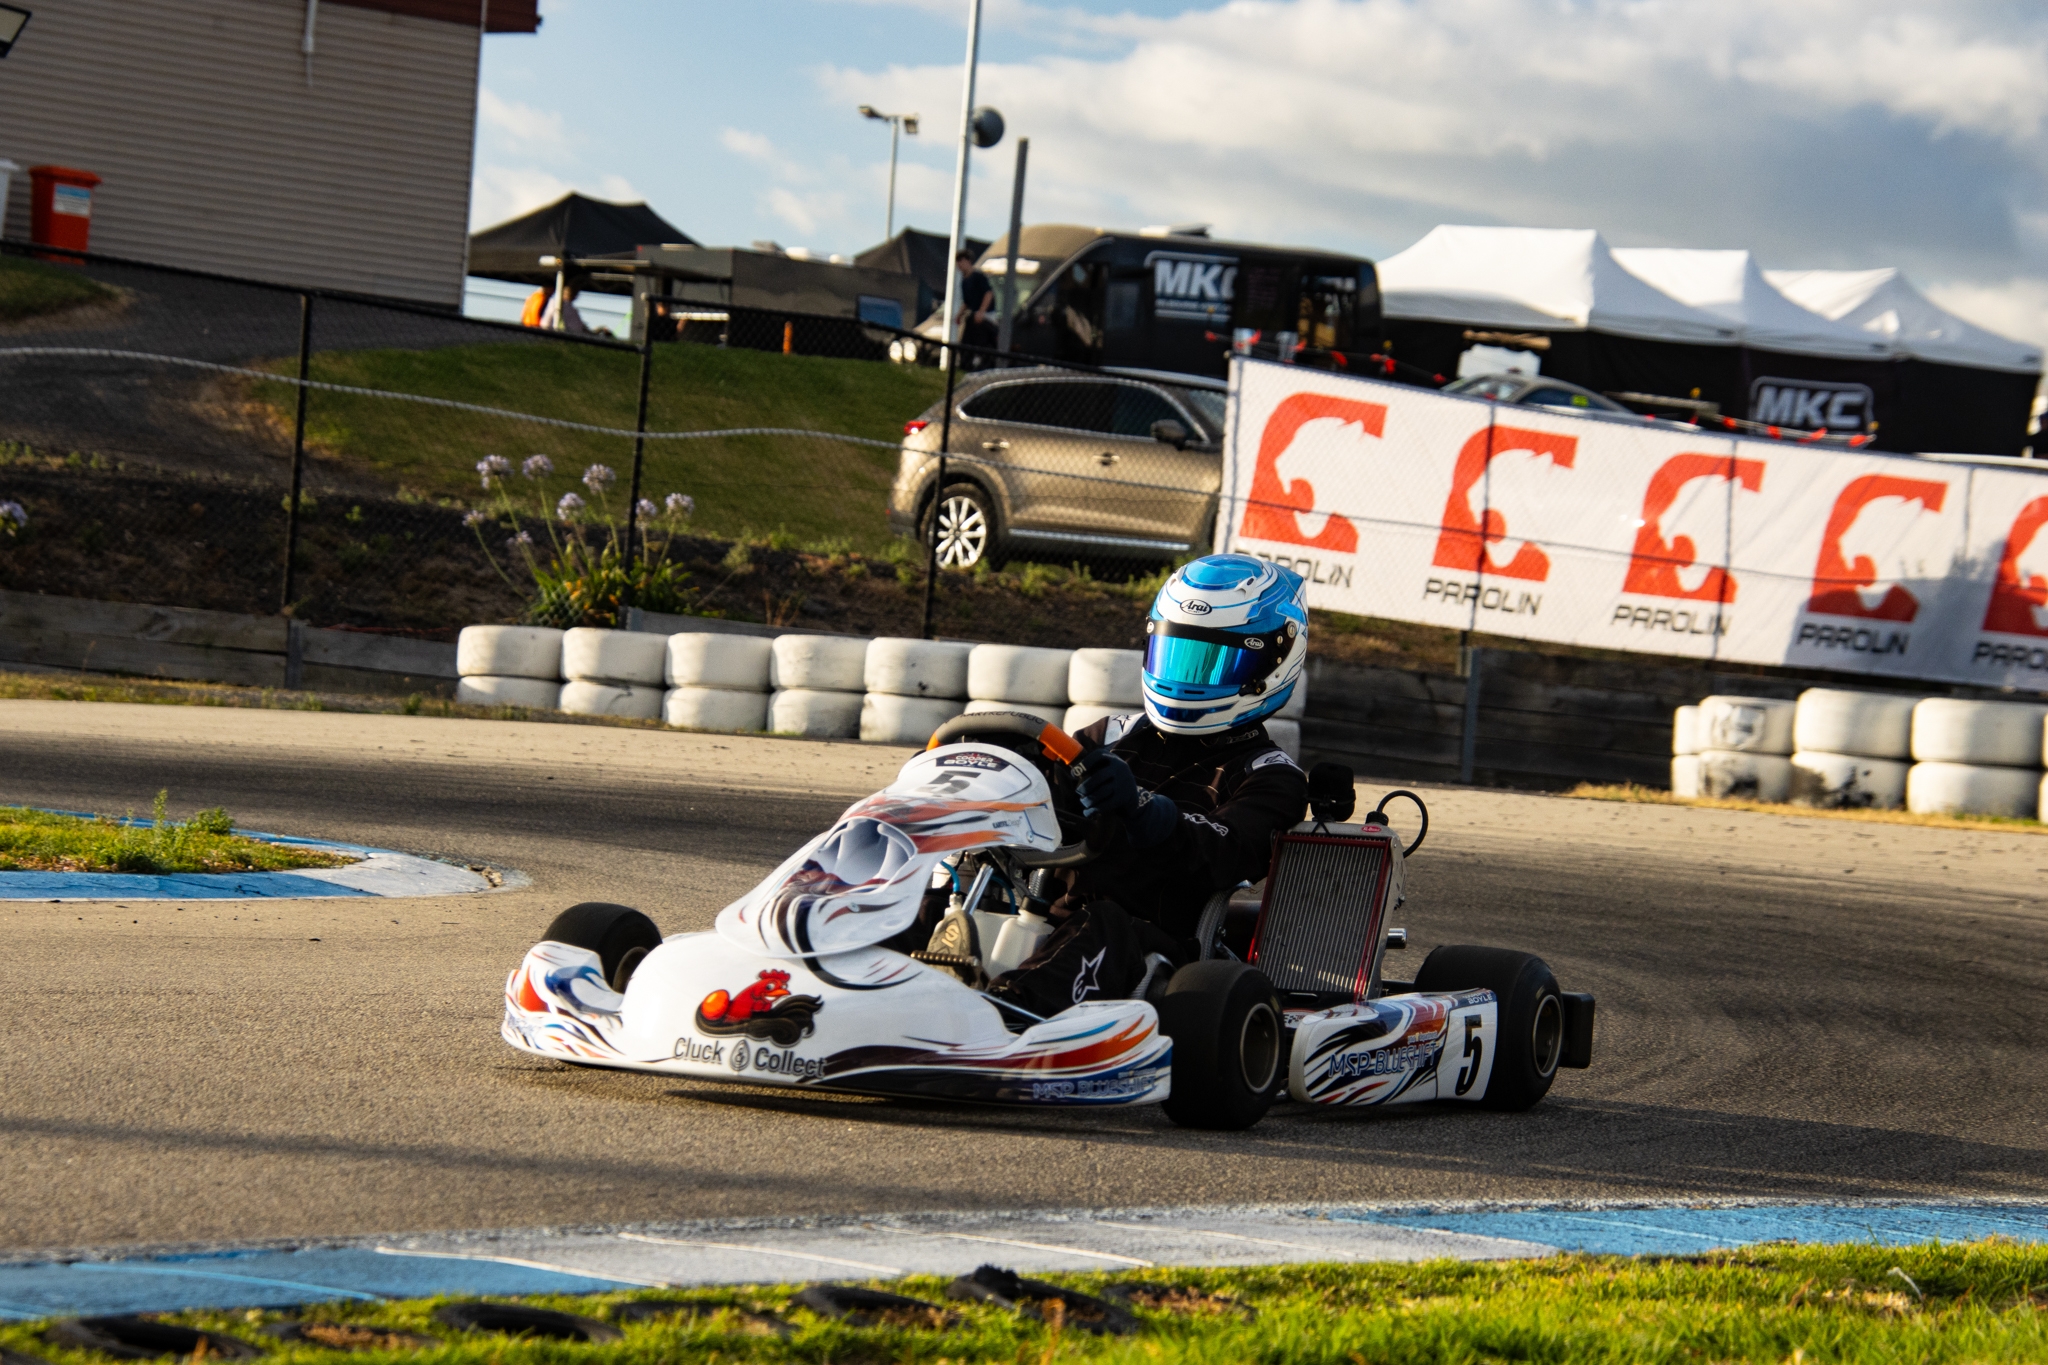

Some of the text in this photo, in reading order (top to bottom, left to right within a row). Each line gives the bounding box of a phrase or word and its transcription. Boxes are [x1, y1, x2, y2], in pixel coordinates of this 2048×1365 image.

[1755, 386, 1866, 428] MKC
[1187, 600, 1208, 612] Arai
[1423, 577, 1543, 615] PAROLIN
[1611, 604, 1733, 637] PAROLIN
[1797, 622, 1909, 655] PAROLIN
[1970, 641, 2048, 672] PARO
[943, 759, 998, 768] BOYLE
[915, 770, 981, 797] 5
[1467, 993, 1493, 1005] BOYLE
[673, 1037, 725, 1065] Cluck
[754, 1046, 826, 1077] Collect
[1328, 1041, 1439, 1077] MSP BLUESHIFT
[1454, 1013, 1483, 1096] 5
[1032, 1075, 1157, 1099] MSP BLUESHIFT
